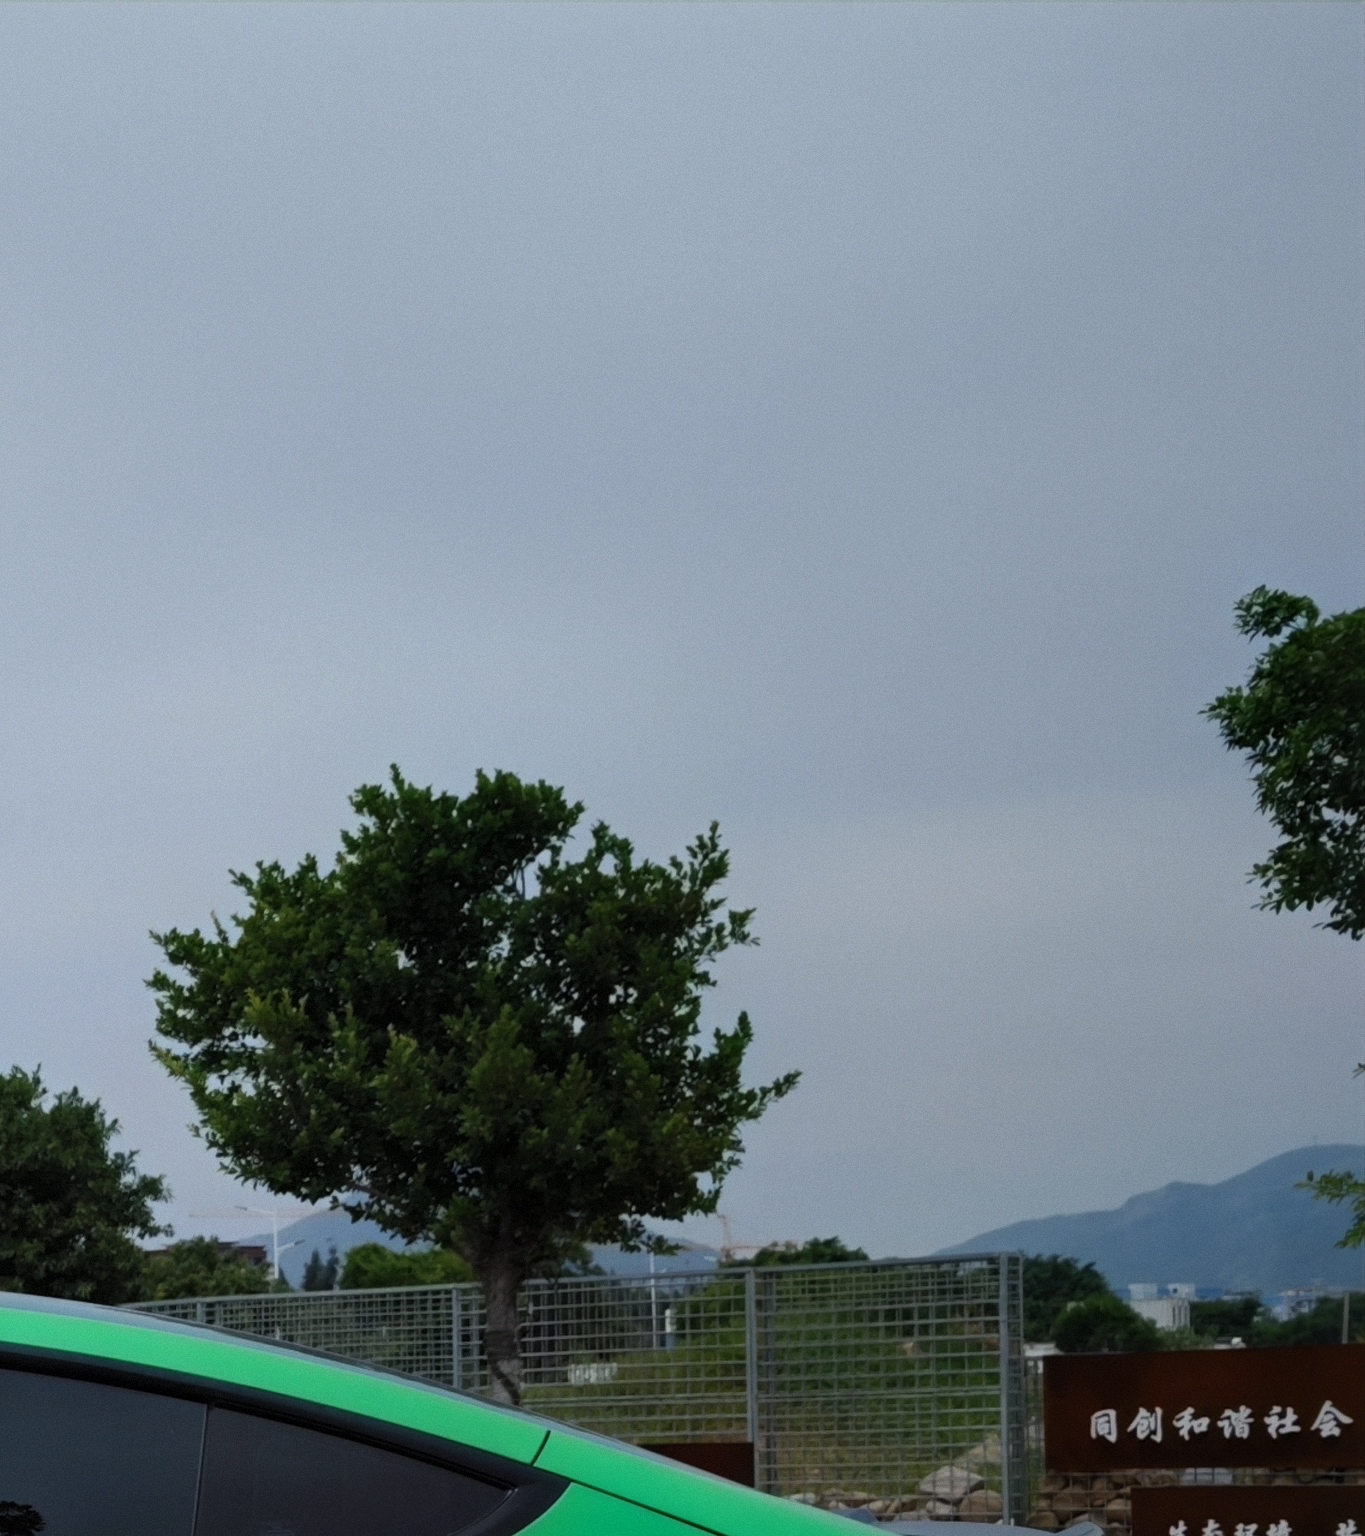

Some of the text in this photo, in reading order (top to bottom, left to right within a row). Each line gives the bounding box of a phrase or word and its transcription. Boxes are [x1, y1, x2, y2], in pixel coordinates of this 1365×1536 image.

[1089, 1400, 1354, 1444] 同创和谐社会
